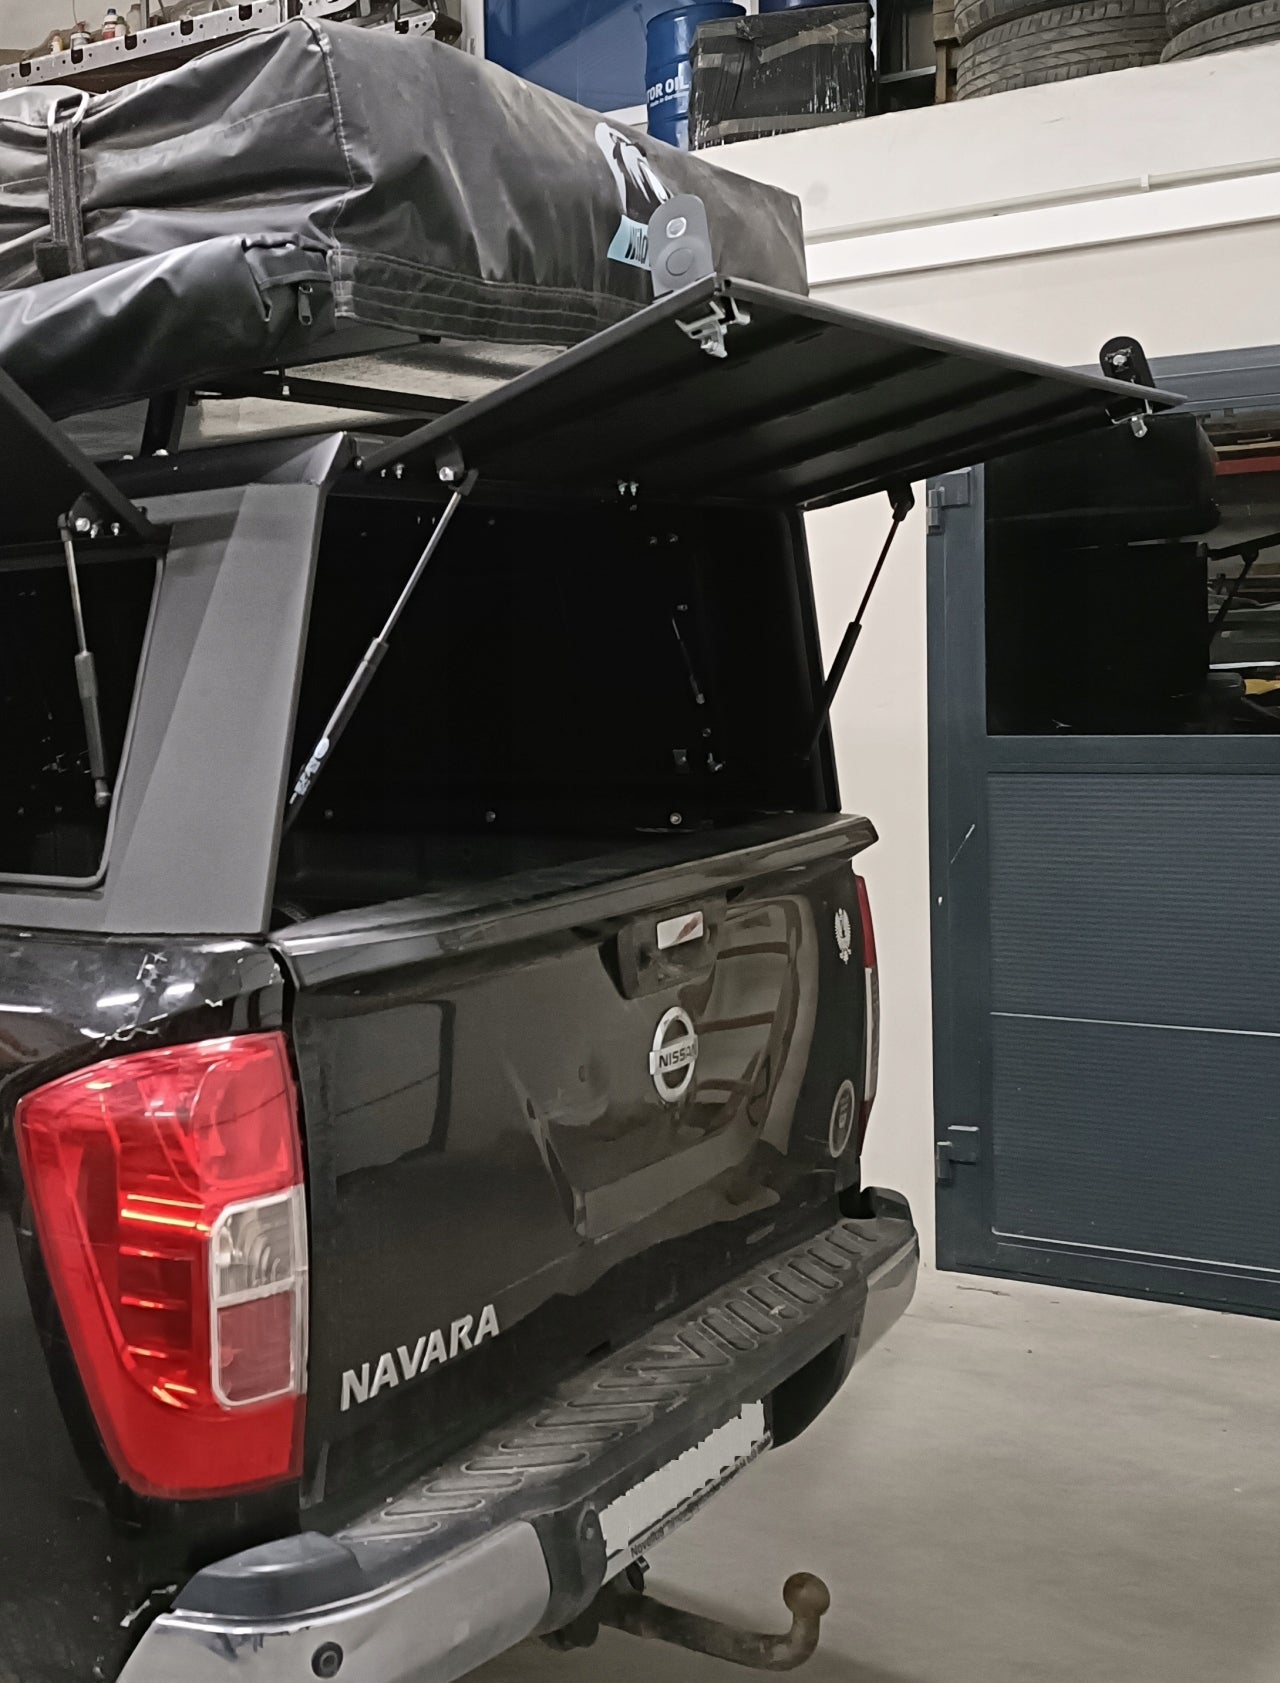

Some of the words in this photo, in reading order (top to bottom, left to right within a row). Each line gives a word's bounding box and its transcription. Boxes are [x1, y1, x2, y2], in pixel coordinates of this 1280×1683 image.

[665, 75, 690, 93] OIL
[658, 1041, 698, 1069] NISSAN
[340, 1303, 500, 1412] NAVARA
